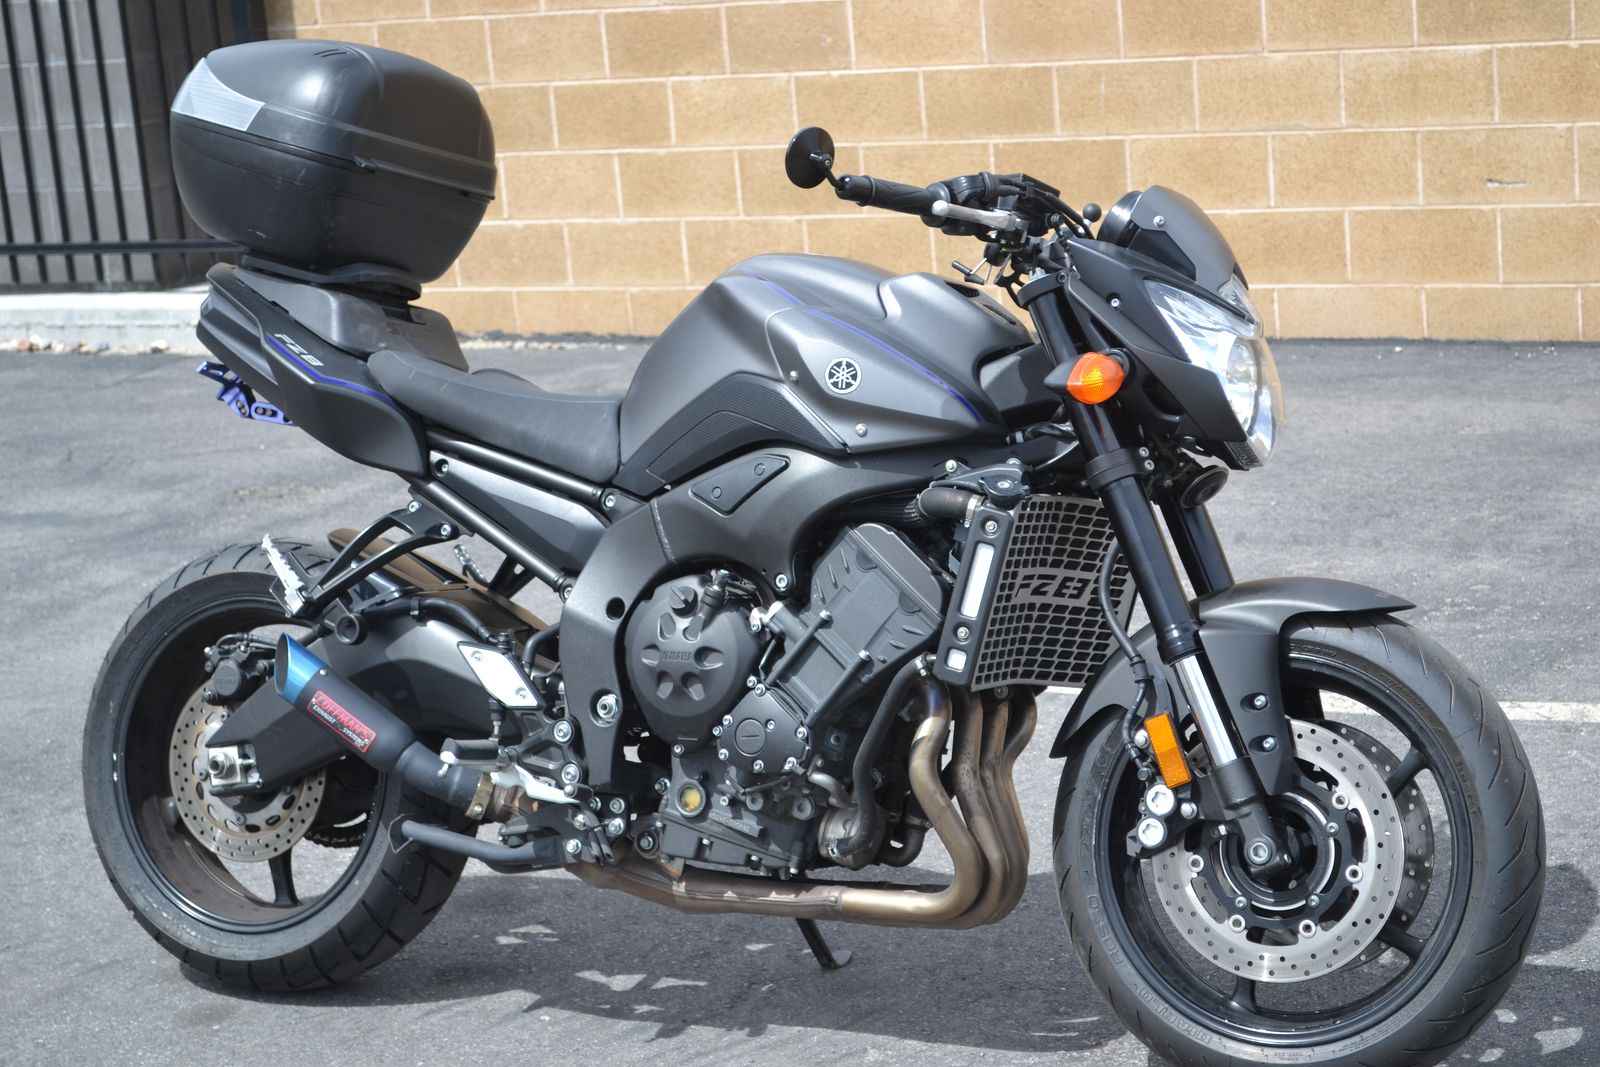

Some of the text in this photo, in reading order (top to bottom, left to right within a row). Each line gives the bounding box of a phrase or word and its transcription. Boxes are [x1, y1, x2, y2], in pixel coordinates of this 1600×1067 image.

[273, 334, 324, 366] FZ8
[1015, 574, 1092, 599] FZ8
[313, 705, 366, 746] EXHAUST SYSTEMS
[316, 697, 370, 740] COFFMAN'S
